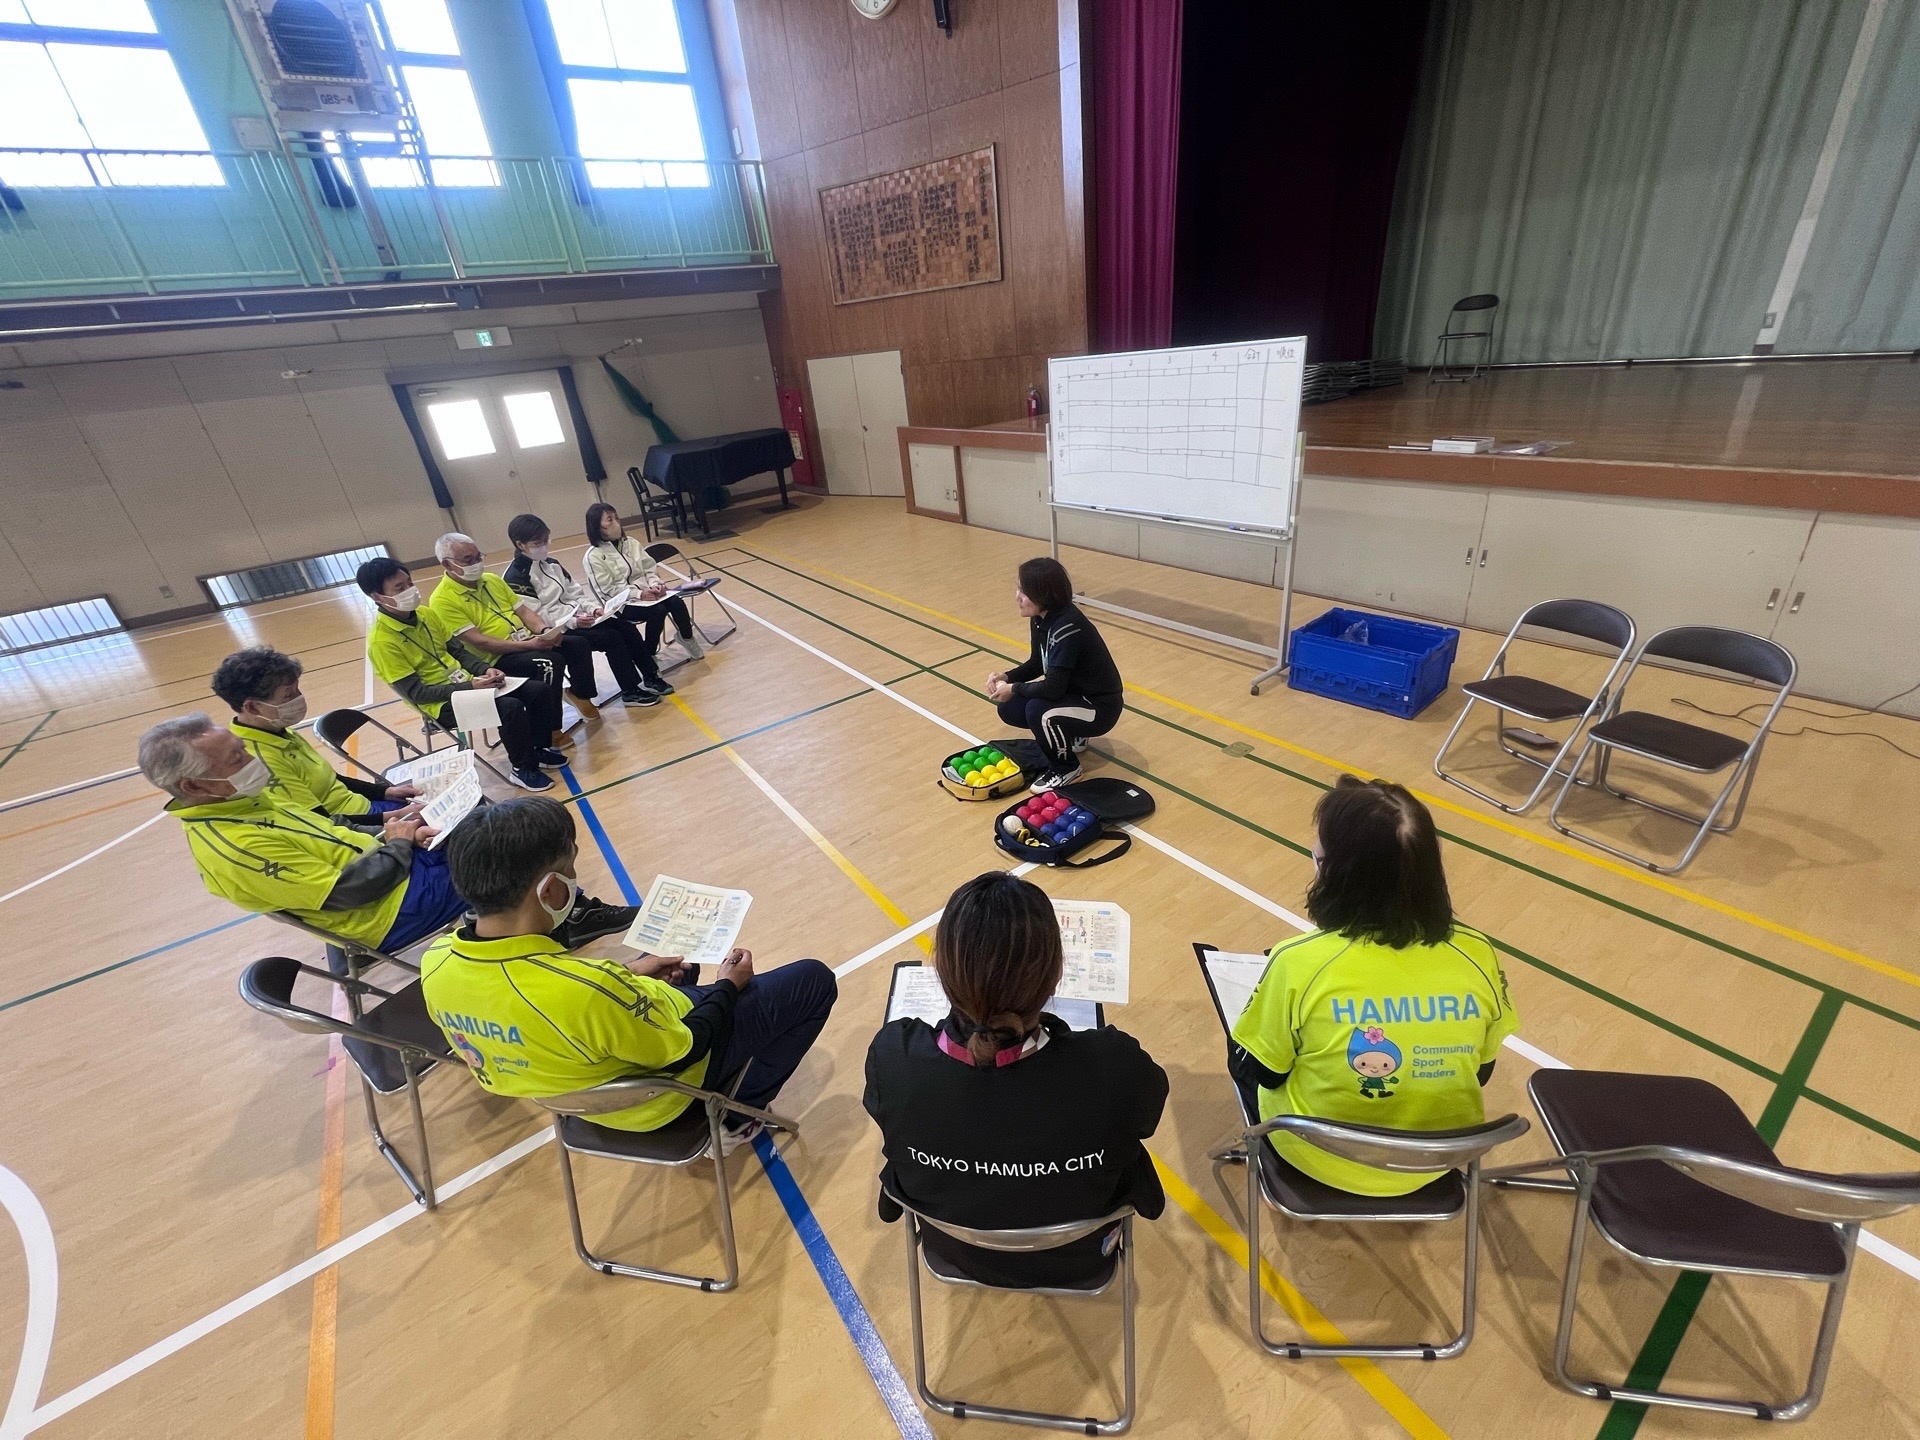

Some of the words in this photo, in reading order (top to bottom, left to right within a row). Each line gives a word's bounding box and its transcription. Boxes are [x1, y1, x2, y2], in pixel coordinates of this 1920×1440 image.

[320, 94, 354, 105] GBS-4
[1128, 359, 1133, 367] 2
[1167, 356, 1172, 365] 3
[1212, 350, 1219, 362] 4
[1244, 347, 1261, 362] 合計
[1276, 346, 1295, 360] 順位
[1332, 994, 1480, 1024] HAMURA
[1412, 1045, 1476, 1055] Community
[1412, 1058, 1444, 1067] Sport
[1412, 1068, 1456, 1079] Leaders
[907, 1146, 970, 1172] TOKYO
[974, 1161, 1060, 1177] HAMURA
[1065, 1149, 1105, 1172] CITY
